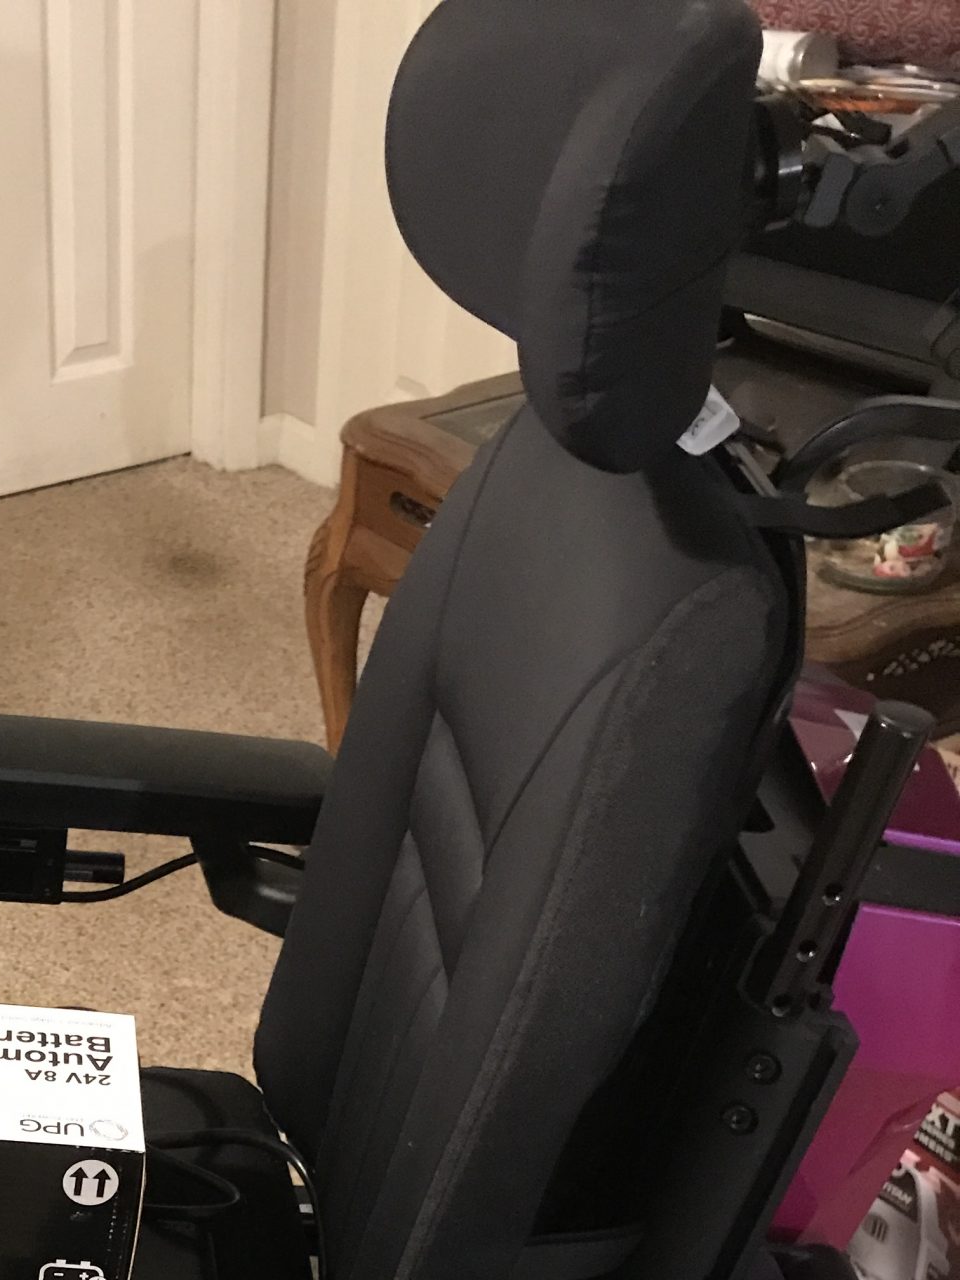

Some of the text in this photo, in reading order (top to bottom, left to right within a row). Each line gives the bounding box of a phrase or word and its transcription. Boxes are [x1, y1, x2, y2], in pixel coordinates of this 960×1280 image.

[24, 1069, 111, 1086] 24V 8A
[19, 1119, 85, 1137] UPG
